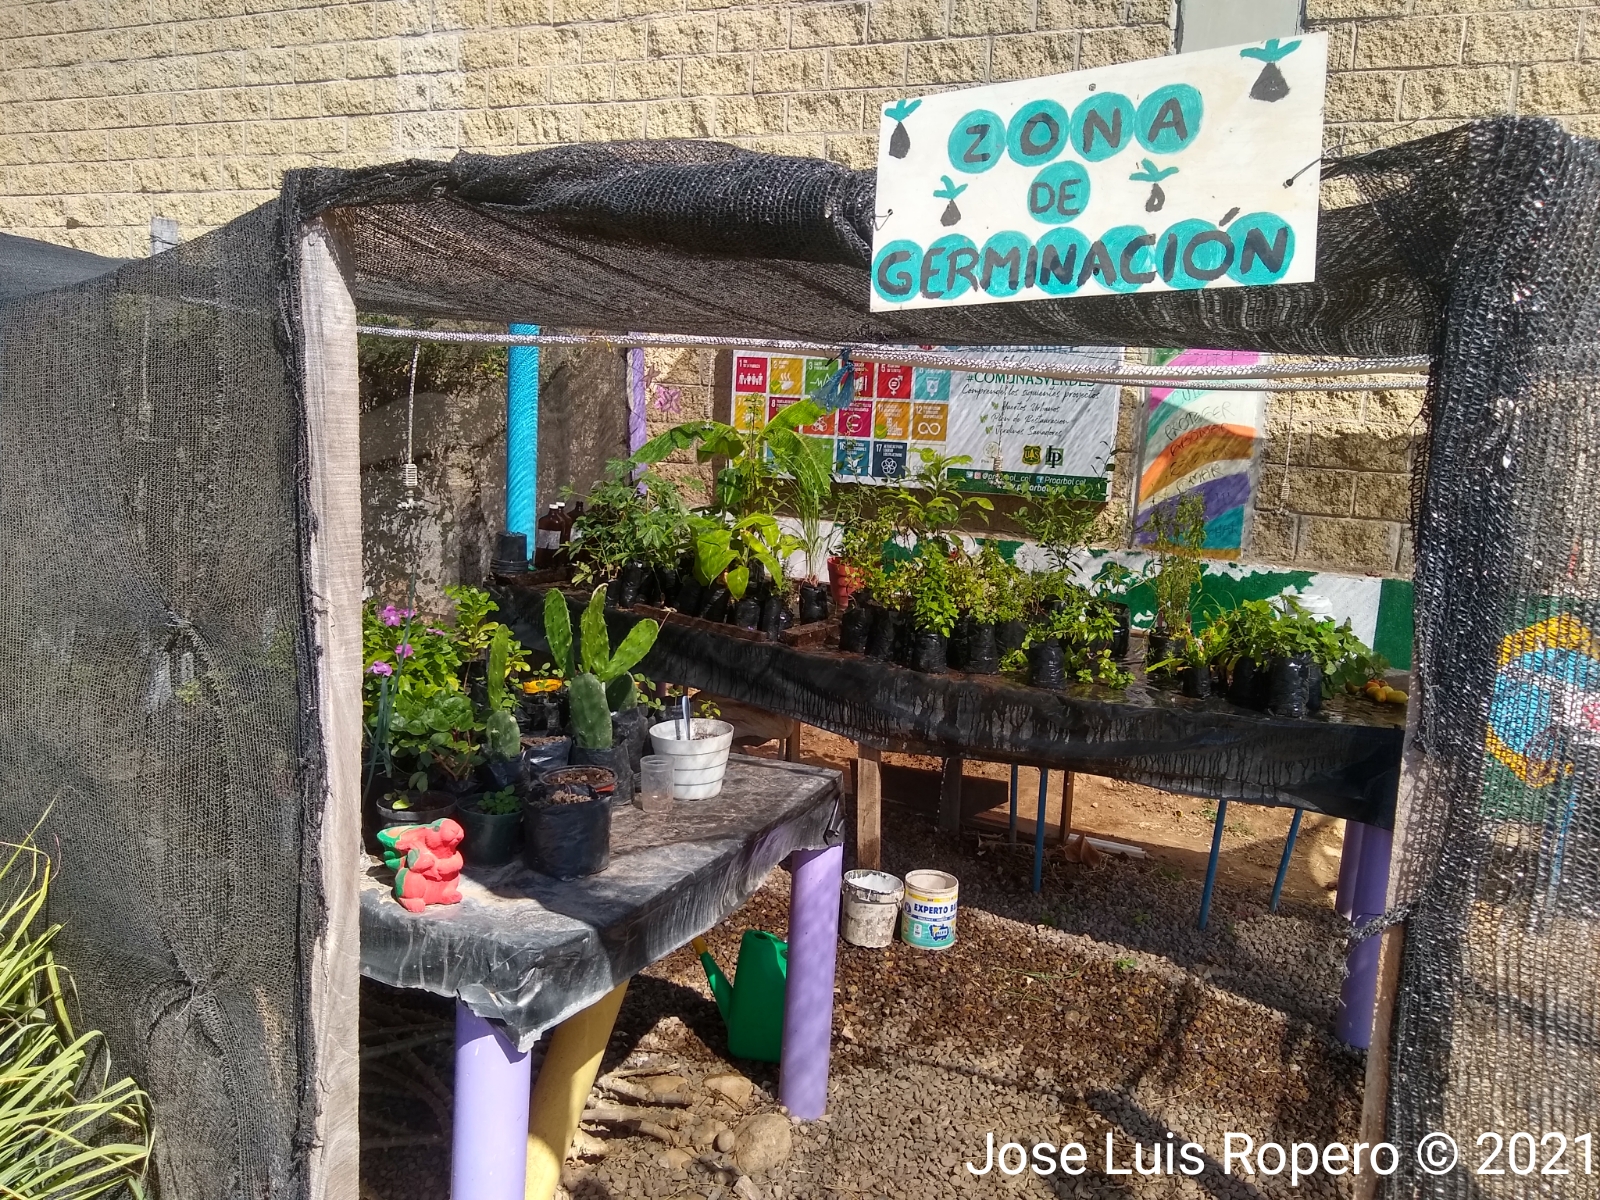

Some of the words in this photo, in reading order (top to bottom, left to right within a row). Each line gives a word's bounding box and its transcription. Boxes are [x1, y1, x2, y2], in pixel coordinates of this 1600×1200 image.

[963, 97, 1188, 164] ZONA
[1030, 177, 1082, 216] DE
[876, 206, 1290, 299] GERMINACIÓN
[914, 903, 949, 915] EXPERTO
